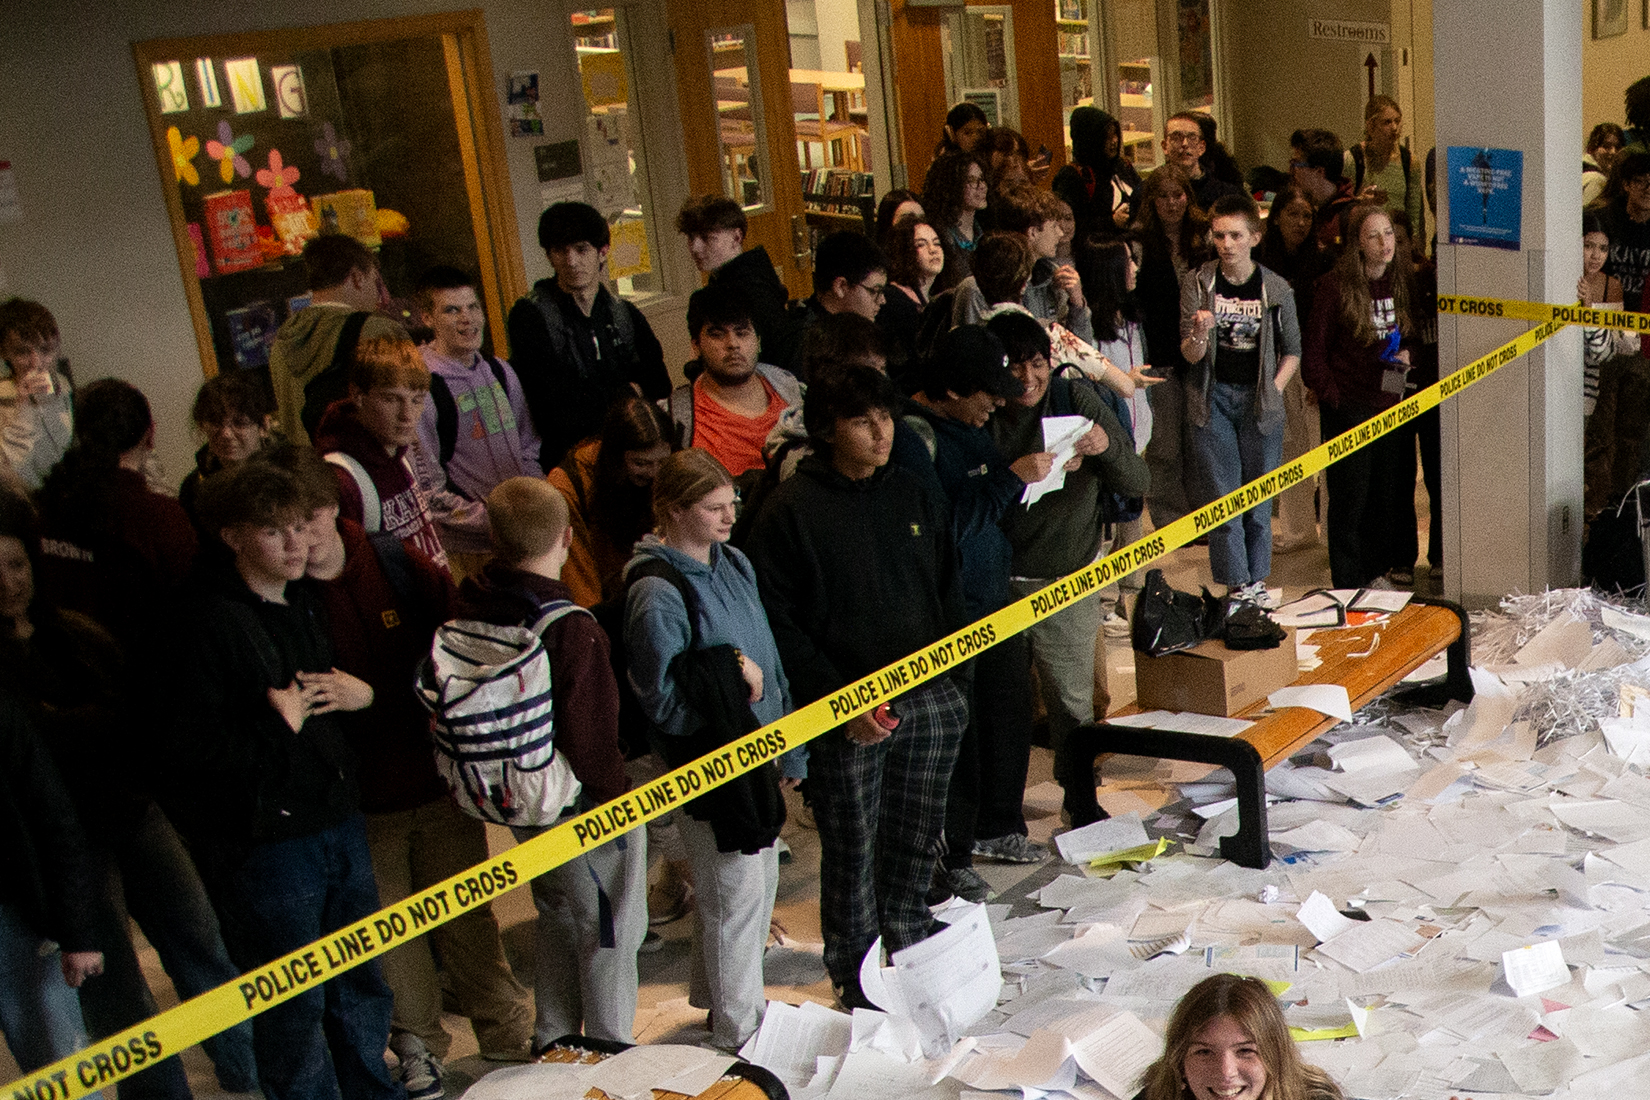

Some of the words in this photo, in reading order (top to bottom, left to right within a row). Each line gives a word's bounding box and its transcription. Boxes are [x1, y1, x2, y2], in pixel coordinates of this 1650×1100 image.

[1313, 21, 1386, 40] Restrooms
[1438, 298, 1456, 311] OT
[1459, 300, 1504, 317] CROSS
[1552, 307, 1600, 325] POLICE
[1604, 314, 1634, 328] LINE
[1439, 374, 1462, 398] POLICE
[1462, 363, 1476, 385] LINE
[1476, 361, 1485, 378] DO
[1486, 354, 1498, 372] NOT
[1498, 344, 1518, 365] CROSS
[1327, 434, 1354, 461] POLICE
[1354, 424, 1371, 447] LINE
[1371, 419, 1382, 438] DO
[1382, 411, 1397, 430] NOT
[1397, 400, 1420, 423] CROSS
[1193, 502, 1225, 533] POLICE
[1225, 492, 1246, 516] LINE
[1246, 486, 1259, 505] DO
[1260, 477, 1276, 498] NOT
[1278, 463, 1304, 489] CROSS
[1030, 583, 1070, 618] POLICE
[1069, 571, 1095, 597] LINE
[1094, 563, 1110, 585] DO
[1111, 552, 1132, 576] NOT
[1133, 536, 1165, 566] CROSS
[829, 680, 879, 720] POLICE
[877, 664, 910, 694] LINE
[909, 656, 928, 680] DO
[928, 642, 956, 670] NOT
[957, 623, 996, 656] CROSS
[573, 799, 637, 847] POLICE
[635, 781, 677, 817] LINE
[676, 769, 701, 797] DO
[700, 752, 735, 785] NOT
[736, 729, 787, 768] CROSS
[239, 952, 323, 1010] POLICE
[322, 927, 375, 970] LINE
[374, 912, 408, 945] DO
[407, 890, 451, 930] NOT
[453, 861, 519, 908] CROSS
[77, 1030, 163, 1089] CROSS
